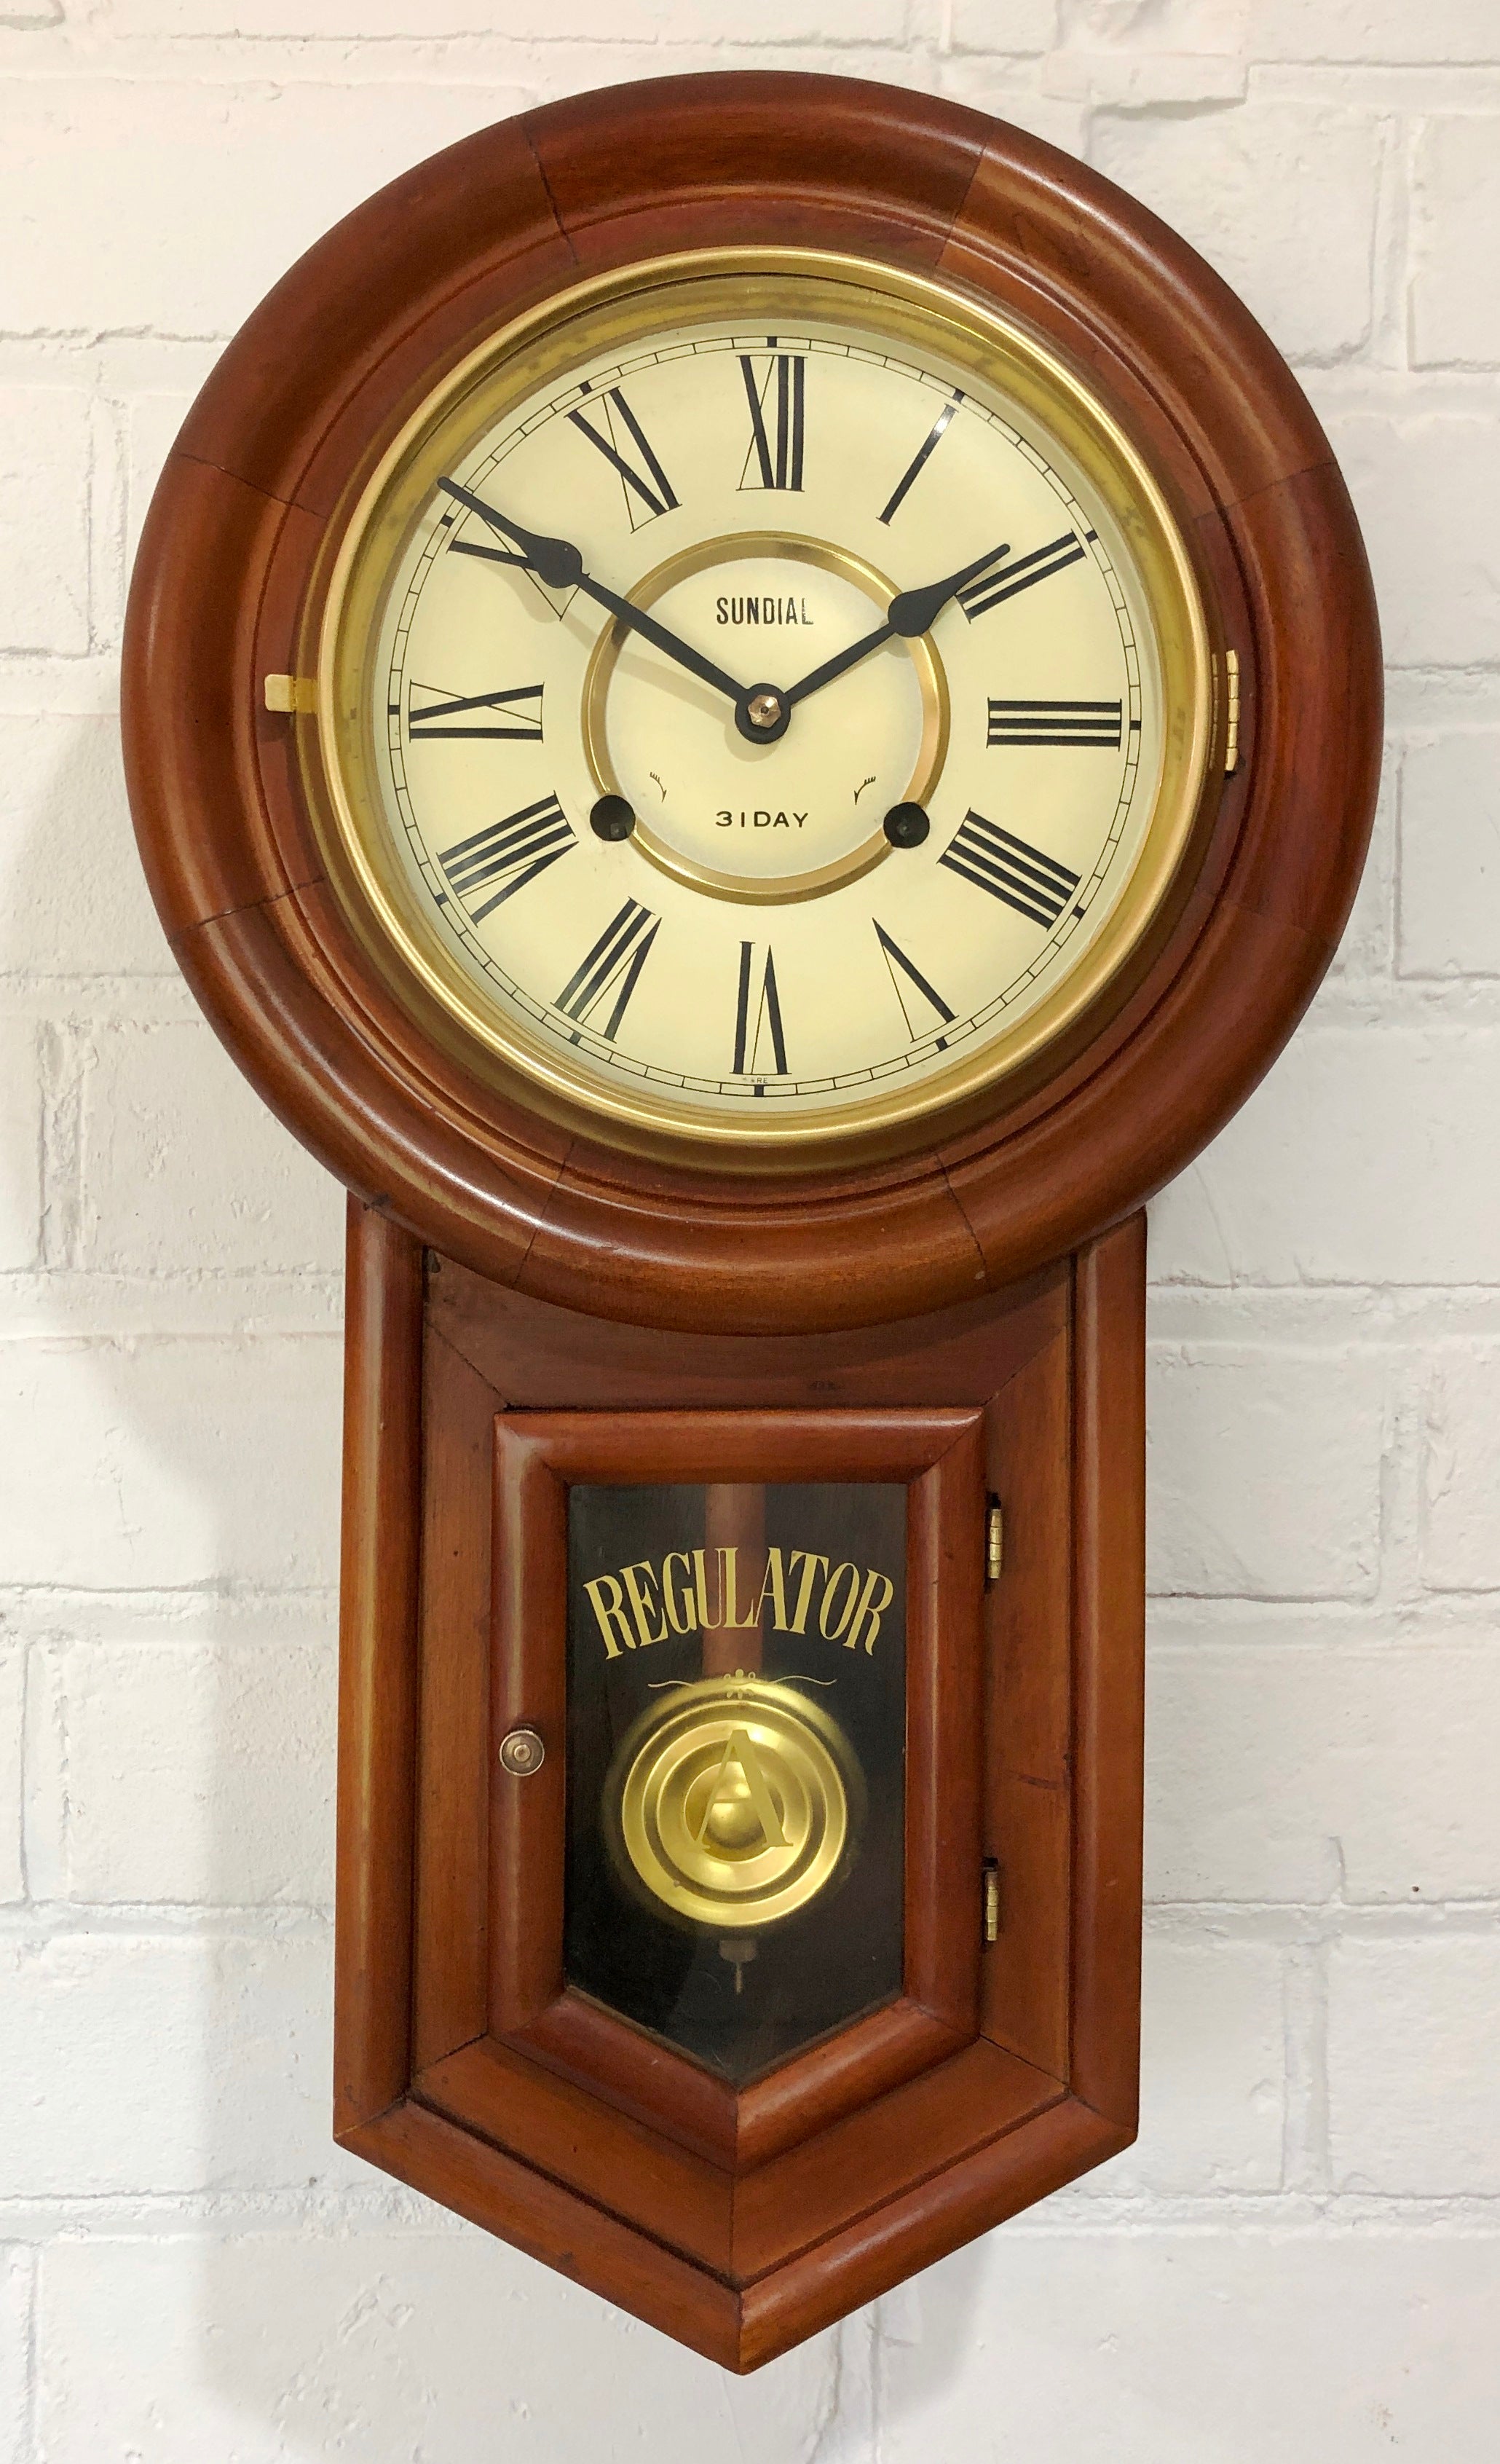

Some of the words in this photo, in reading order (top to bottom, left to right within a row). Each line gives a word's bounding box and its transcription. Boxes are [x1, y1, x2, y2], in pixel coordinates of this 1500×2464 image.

[564, 385, 683, 534] XI
[736, 354, 808, 492] XII
[717, 597, 814, 625] SUNDIAL
[955, 528, 1088, 624] II
[408, 679, 545, 744] IX
[986, 696, 1123, 752] III
[436, 790, 580, 928] VIII
[936, 807, 1083, 932] IIII
[550, 896, 663, 1044] VII
[729, 940, 793, 1076] VI
[872, 917, 960, 1042] V
[583, 1546, 895, 1661] REGULATOR
[693, 1728, 794, 1849] A
